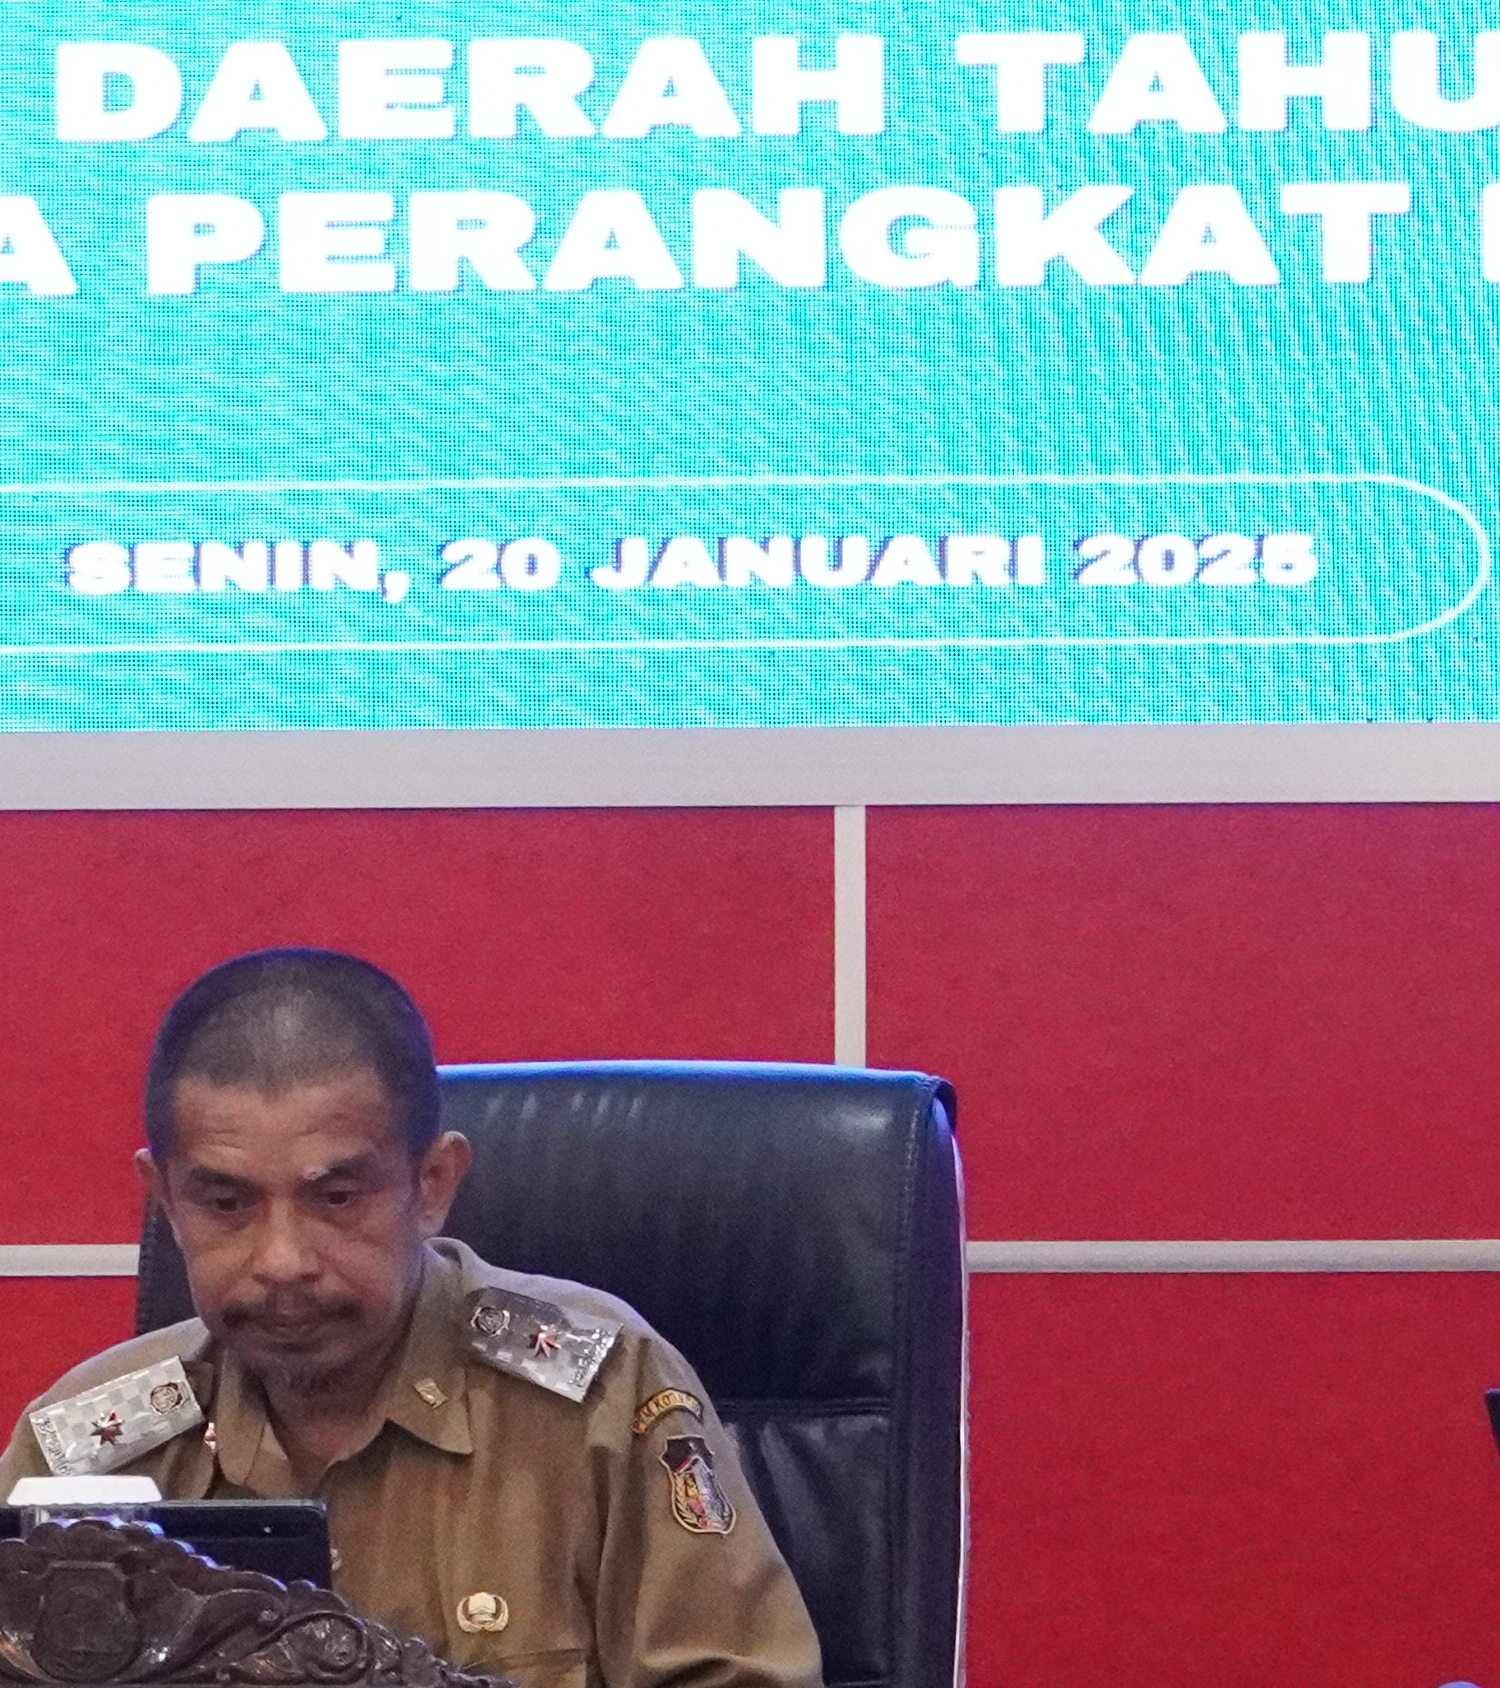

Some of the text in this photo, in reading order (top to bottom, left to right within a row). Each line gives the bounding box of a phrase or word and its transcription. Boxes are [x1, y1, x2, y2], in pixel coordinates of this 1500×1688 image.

[56, 35, 884, 143] DAERAH
[146, 182, 1411, 296] PERANGKAT
[70, 533, 1317, 602] SENIN, 20 JANUARI 2025
